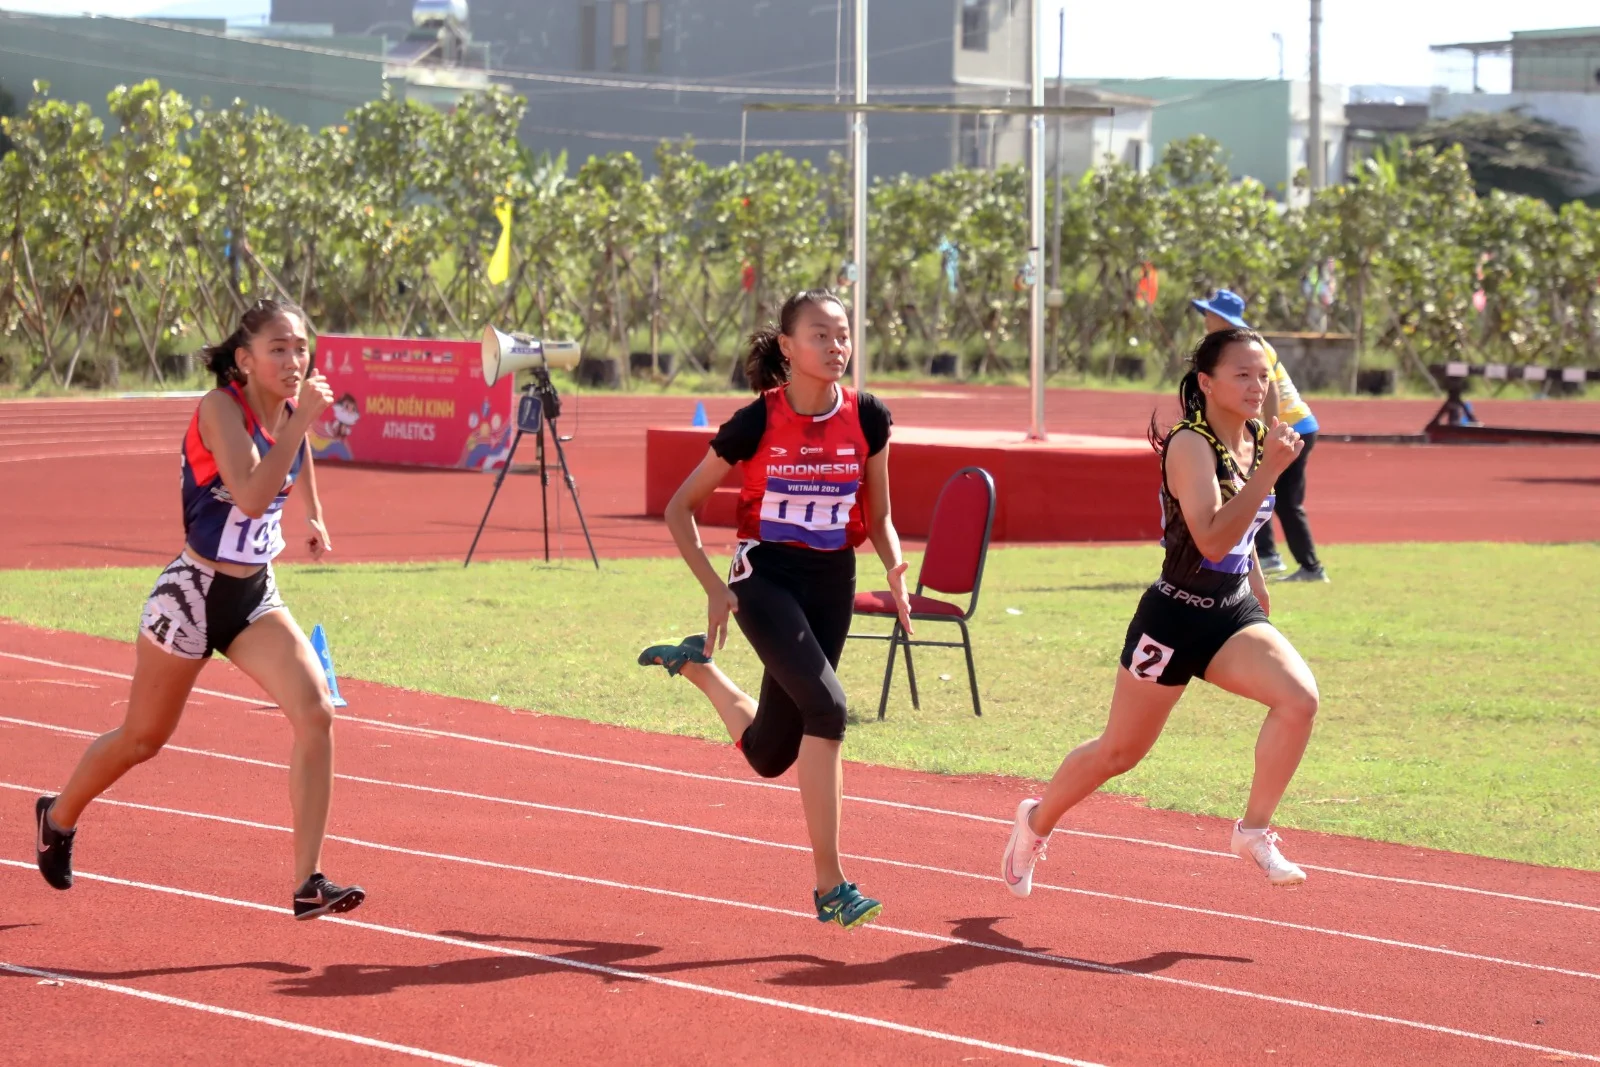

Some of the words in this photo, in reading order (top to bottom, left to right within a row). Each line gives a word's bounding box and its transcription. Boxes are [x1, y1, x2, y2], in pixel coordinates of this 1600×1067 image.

[366, 394, 394, 415] MÔN
[426, 399, 456, 418] KINH
[382, 420, 436, 441] ATHLETICS
[766, 463, 860, 476] INDONESIA
[788, 484, 820, 493] VIETNAM
[821, 485, 840, 493] 2024
[778, 499, 842, 525] 111
[1173, 588, 1215, 609] PRO
[1135, 643, 1164, 679] 2
